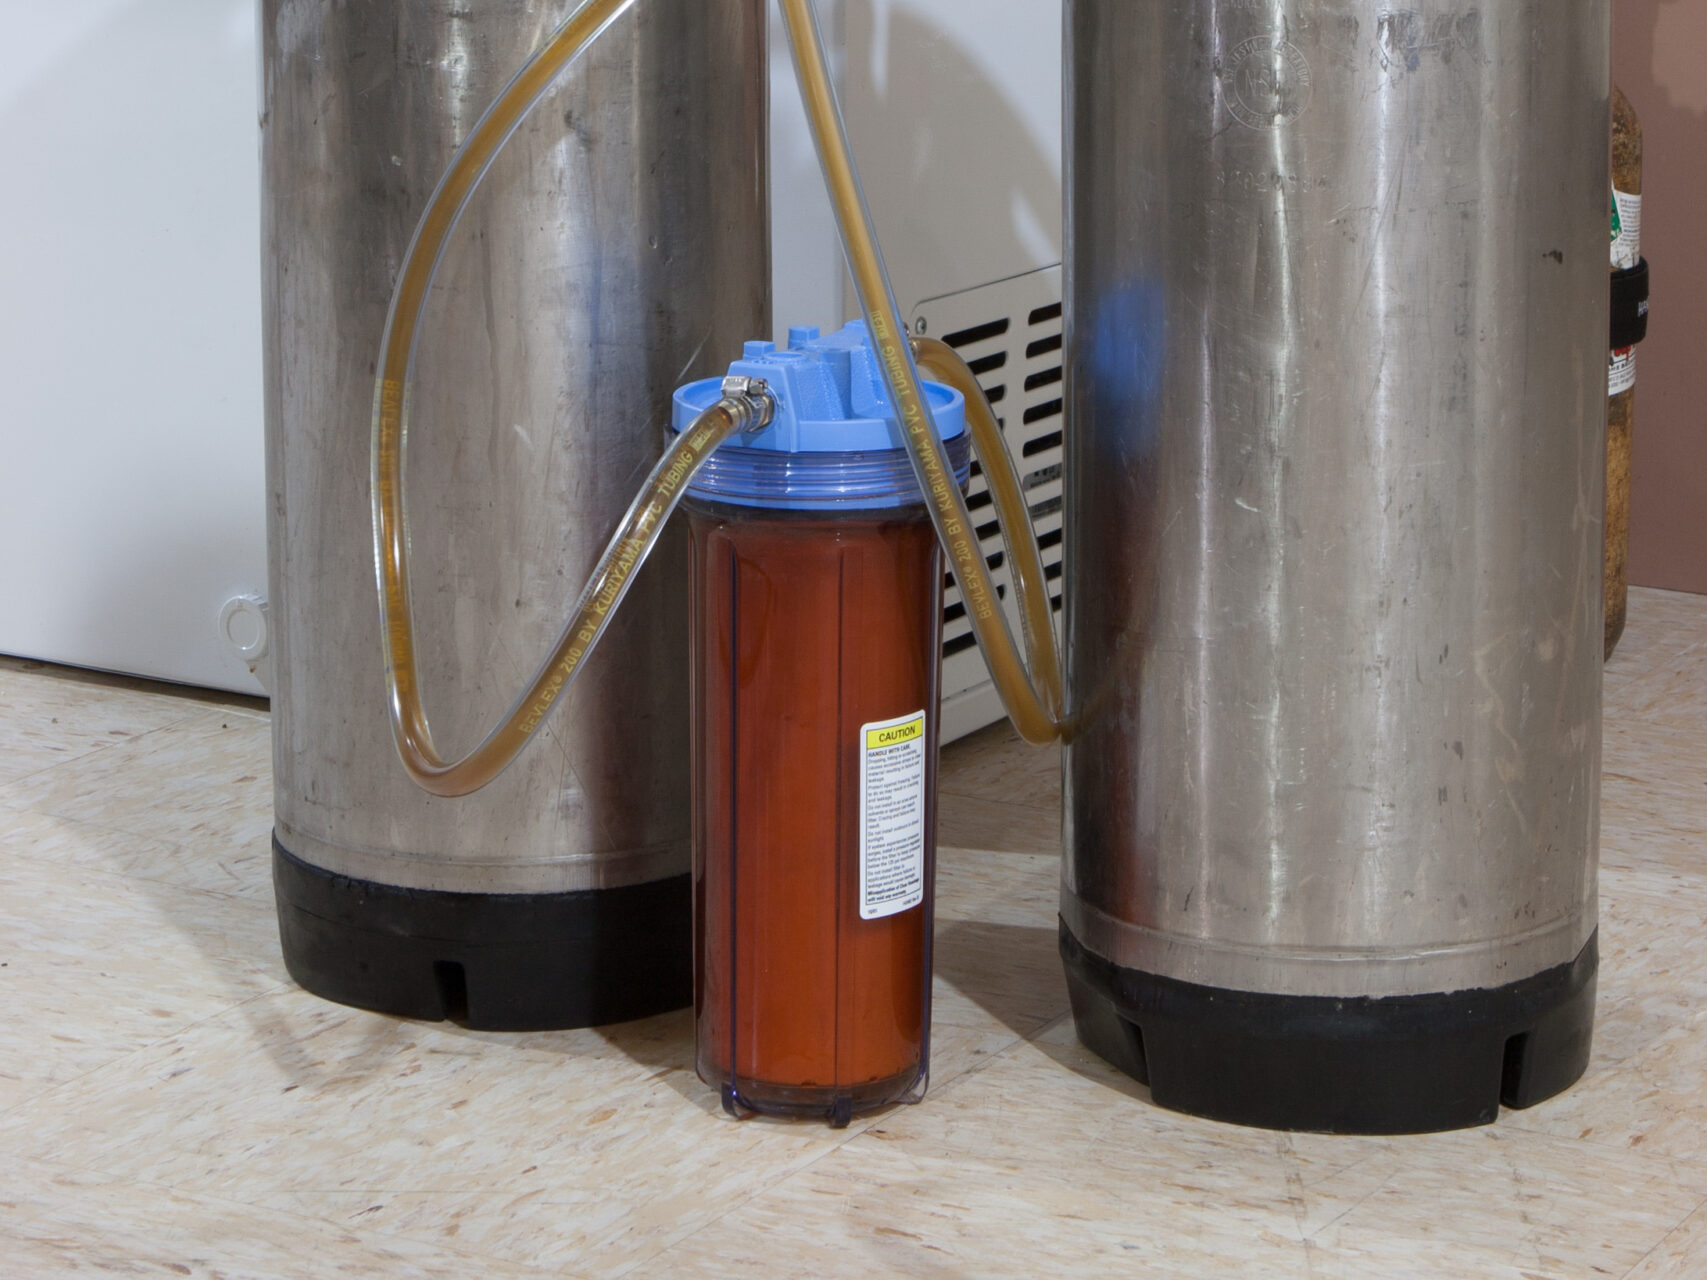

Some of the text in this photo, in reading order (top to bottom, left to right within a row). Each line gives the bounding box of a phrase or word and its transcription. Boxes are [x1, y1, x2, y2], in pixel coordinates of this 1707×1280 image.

[883, 346, 911, 399] TUBING
[903, 404, 925, 434] PVC
[919, 438, 953, 513] KURIYAMA
[943, 514, 963, 536] BY
[560, 647, 582, 674] 200
[578, 619, 597, 643] BY
[593, 537, 645, 617] KURIYAMA
[657, 450, 694, 497] TUBING
[953, 540, 973, 562] 200
[878, 724, 916, 743] CAUTION
